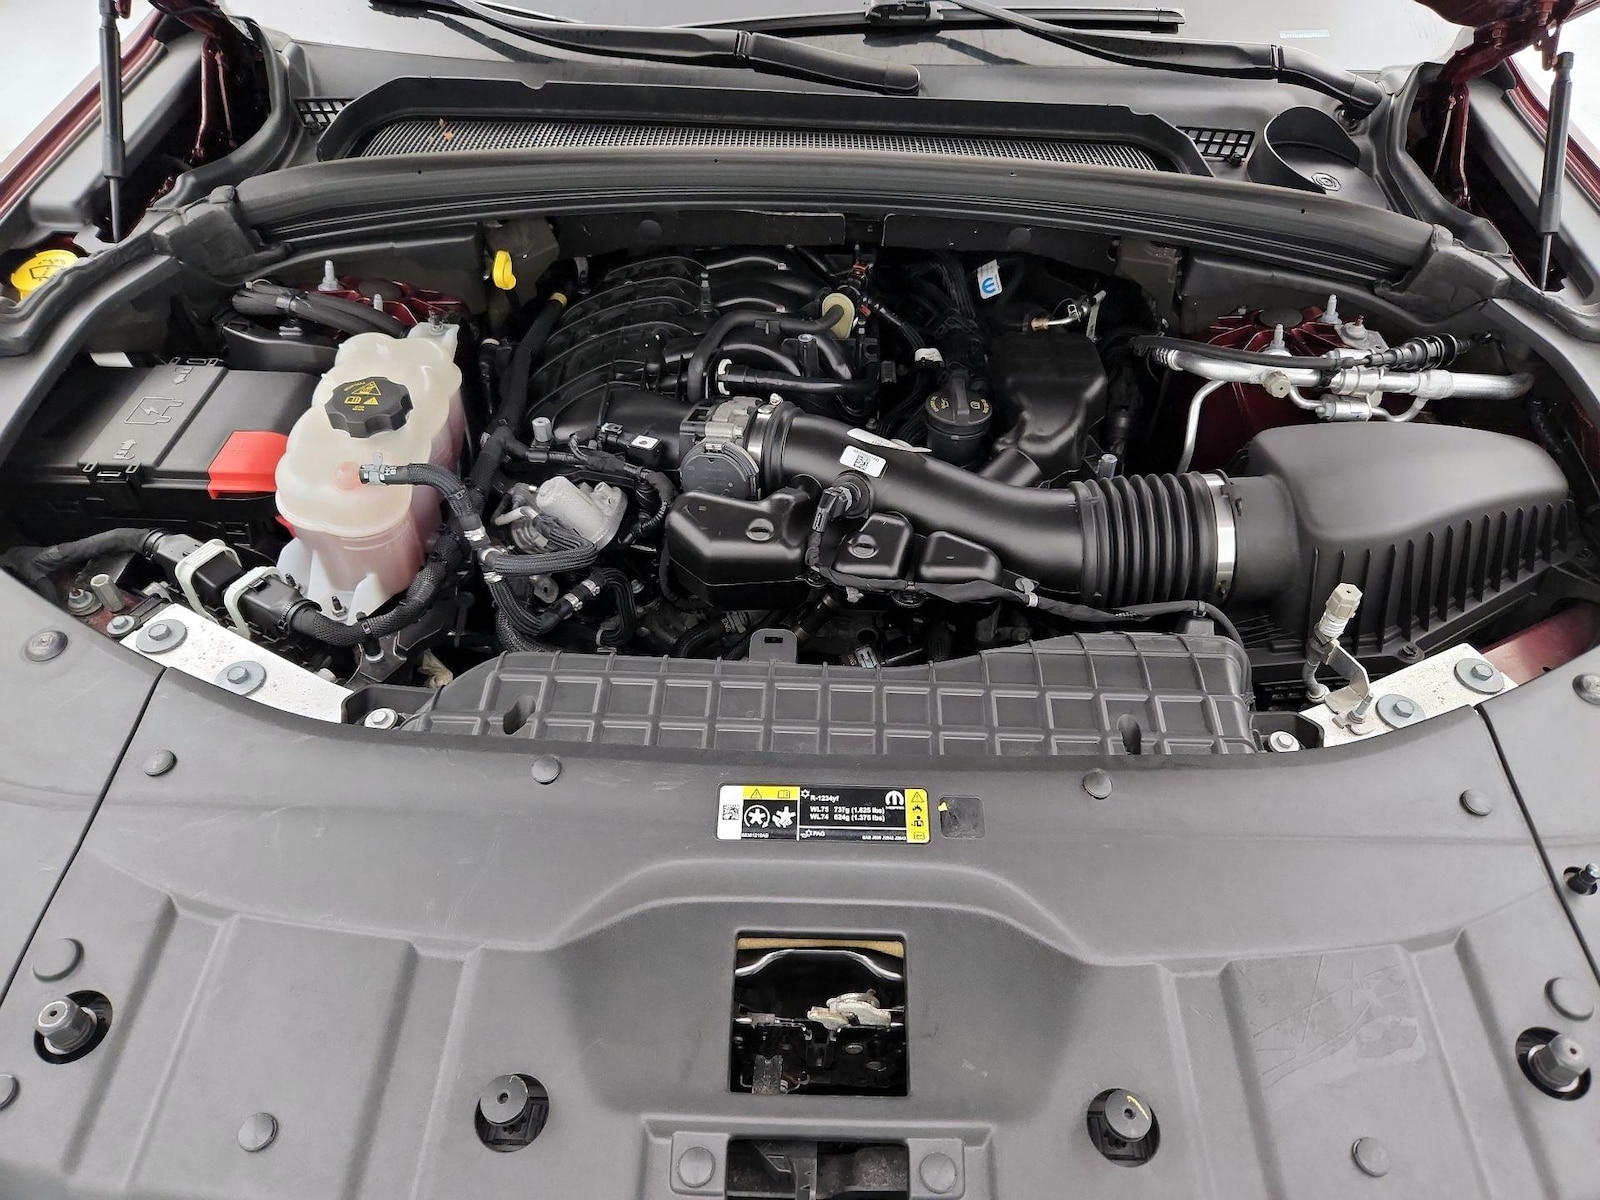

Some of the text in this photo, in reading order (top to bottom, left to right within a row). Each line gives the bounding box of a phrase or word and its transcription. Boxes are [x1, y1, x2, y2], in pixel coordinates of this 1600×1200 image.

[810, 795, 840, 803] R-1234yf
[834, 806, 850, 814] 737g
[872, 806, 886, 815] lbs)
[872, 814, 886, 822] lbs)
